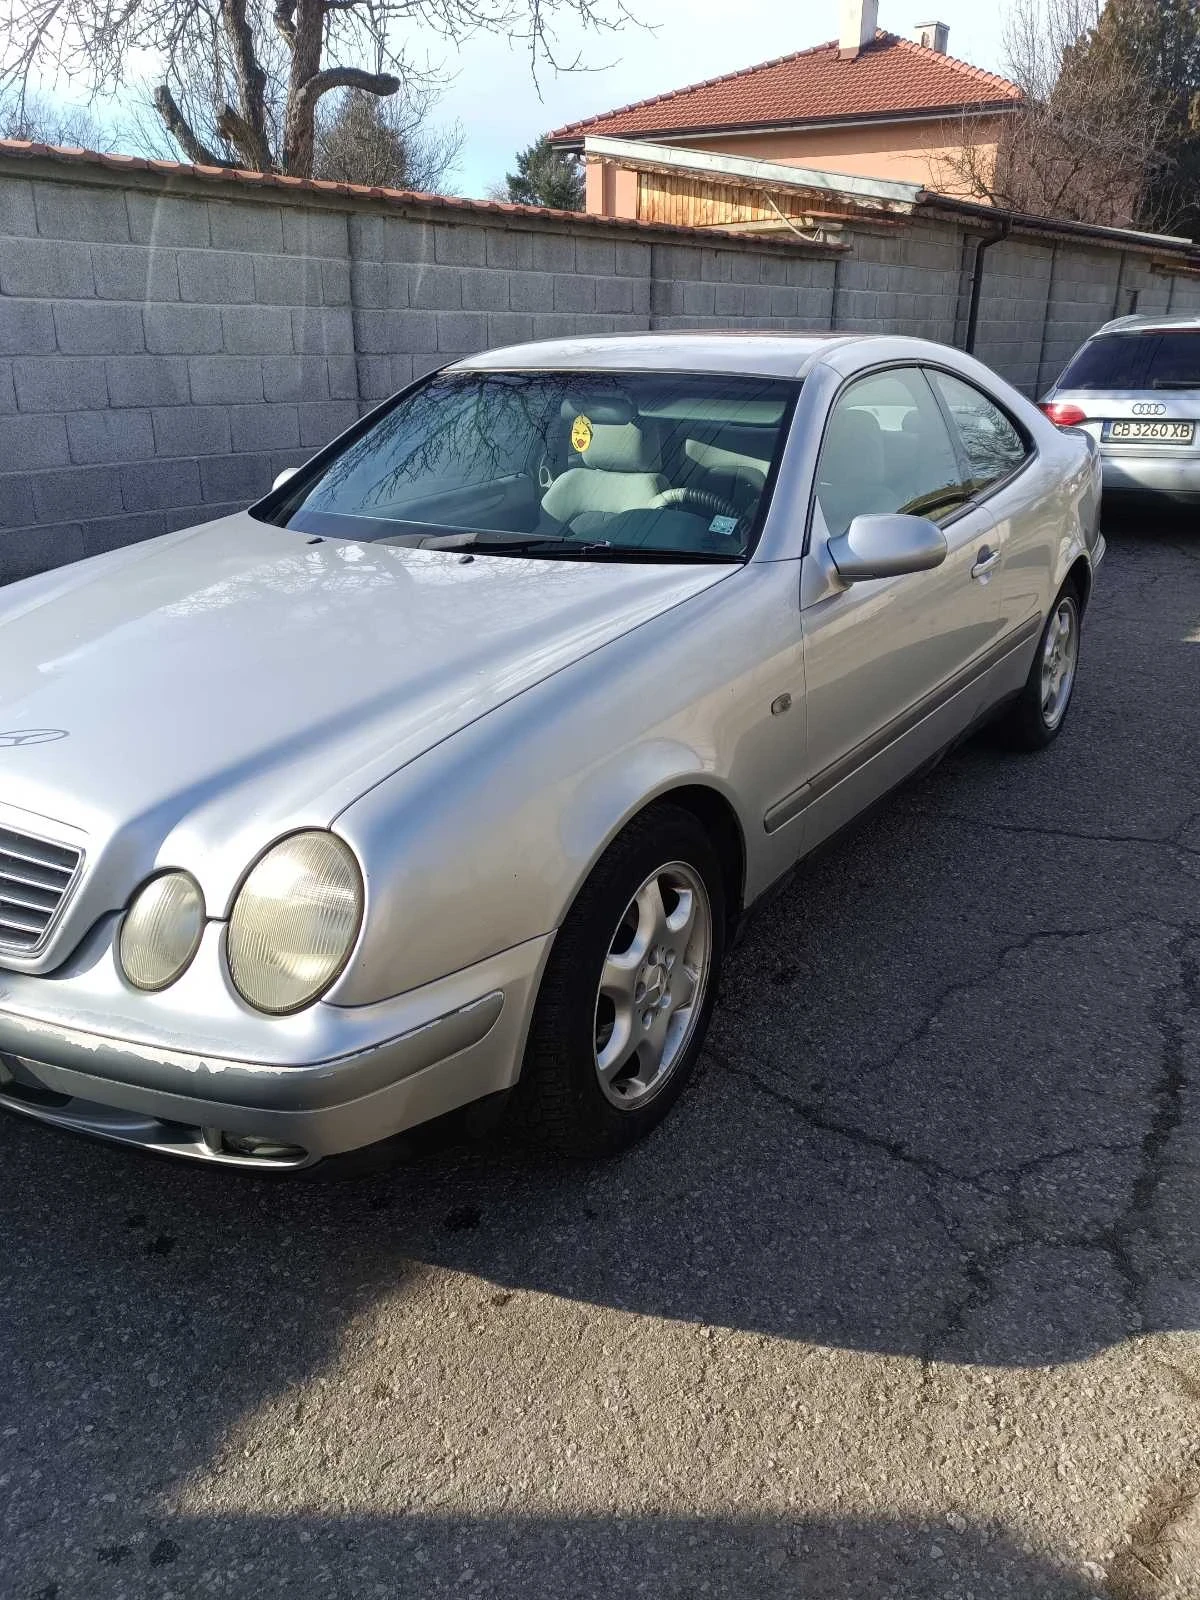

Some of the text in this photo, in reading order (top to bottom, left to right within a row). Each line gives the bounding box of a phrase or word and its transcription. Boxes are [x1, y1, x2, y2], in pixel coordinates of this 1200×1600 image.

[1112, 423, 1190, 438] CB 3260 XB
